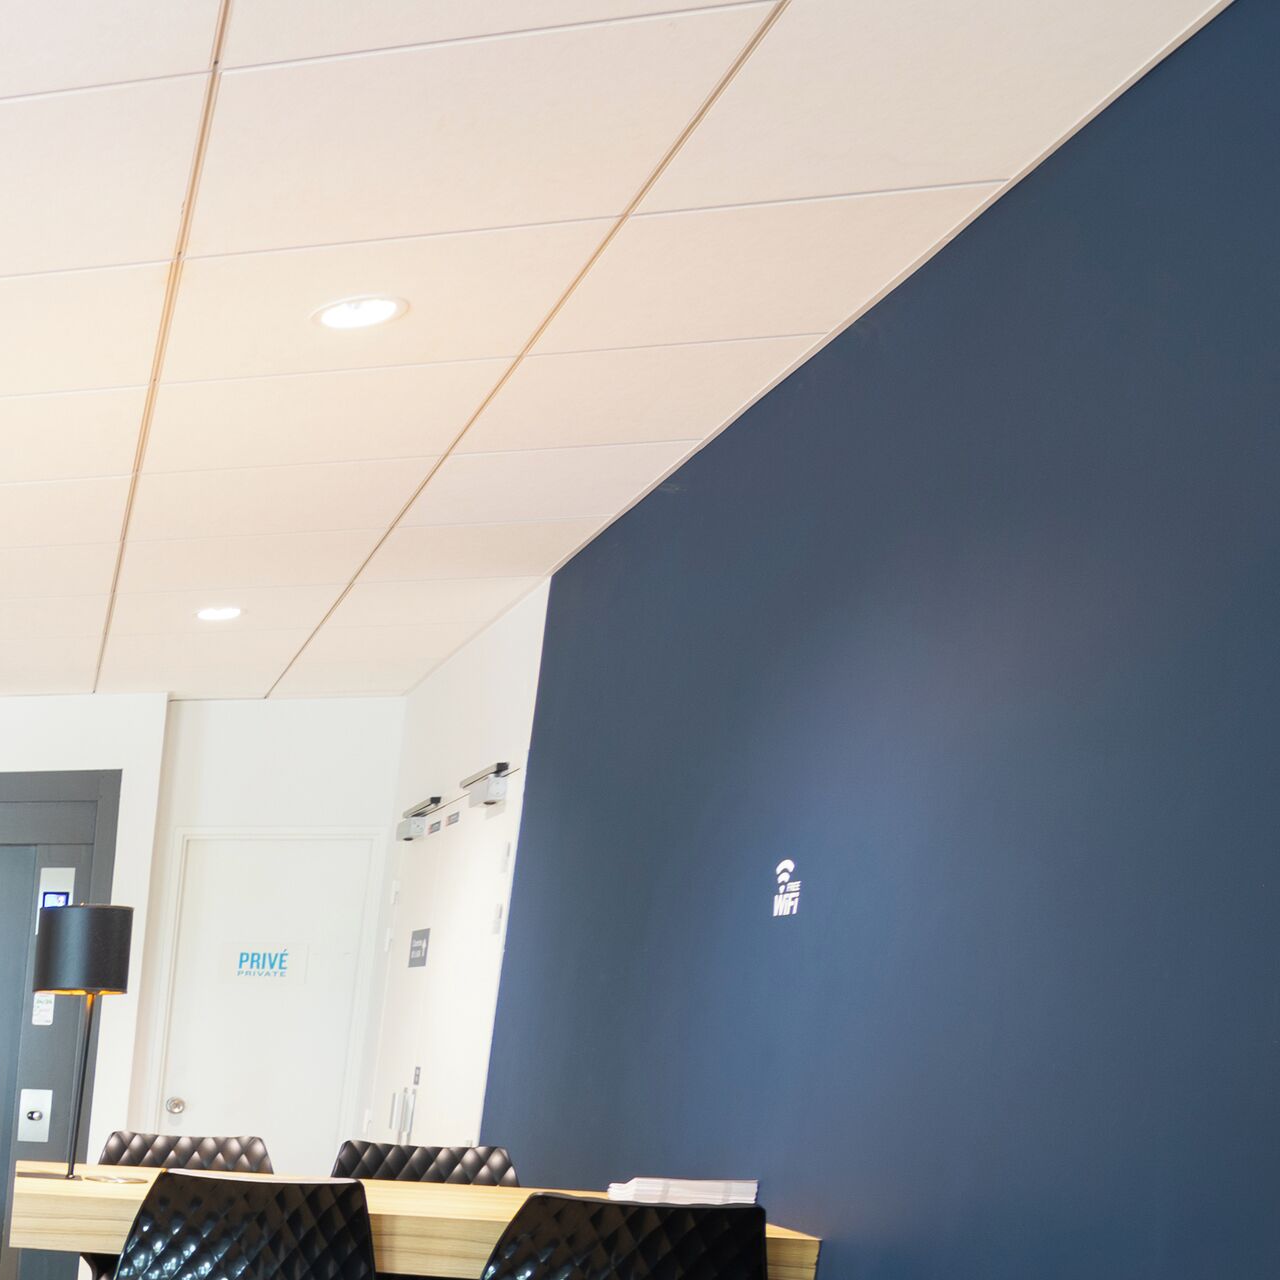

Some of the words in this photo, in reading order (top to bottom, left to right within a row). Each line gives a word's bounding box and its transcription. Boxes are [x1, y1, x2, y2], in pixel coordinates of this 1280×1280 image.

[773, 892, 800, 917] WiFi
[238, 948, 289, 970] PRIVÉ
[236, 970, 287, 978] PRIVATE
